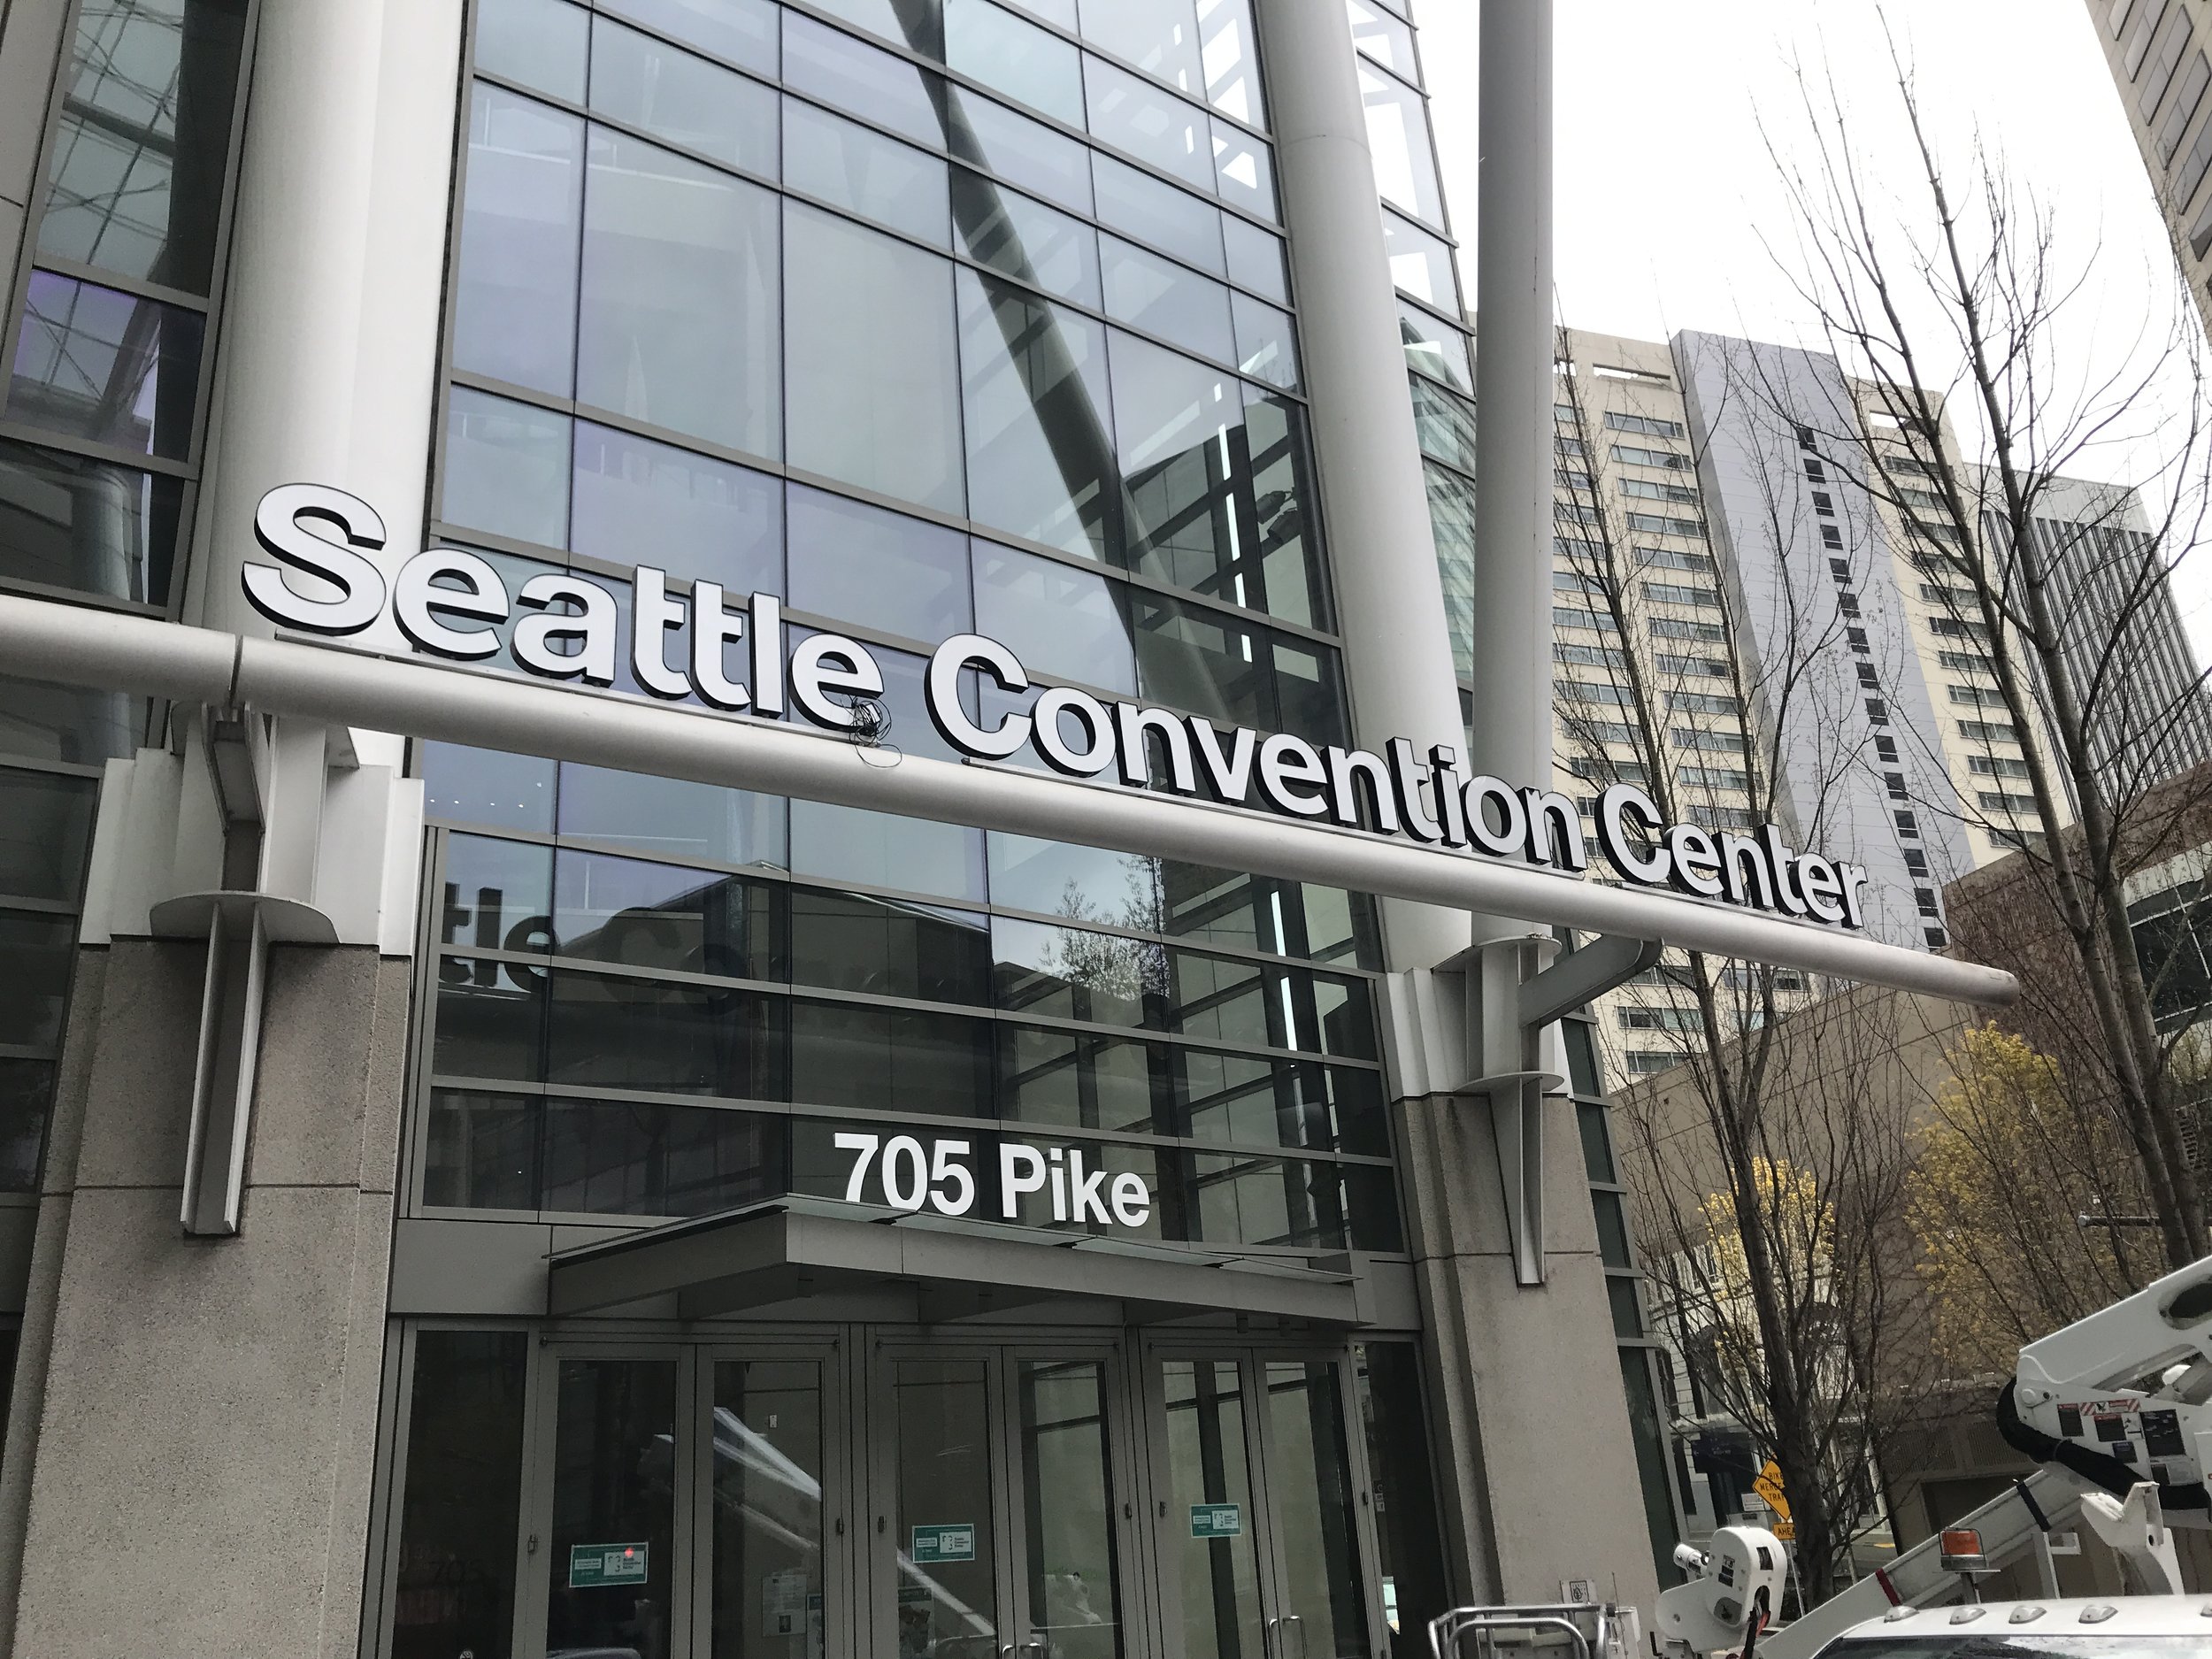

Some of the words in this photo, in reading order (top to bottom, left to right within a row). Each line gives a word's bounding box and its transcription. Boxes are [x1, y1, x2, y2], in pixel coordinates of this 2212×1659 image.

[242, 482, 884, 733] Seattle
[925, 634, 1586, 872] Convention
[1594, 783, 1868, 928] Center
[834, 1133, 975, 1217] 705
[999, 1142, 1150, 1228] Pike
